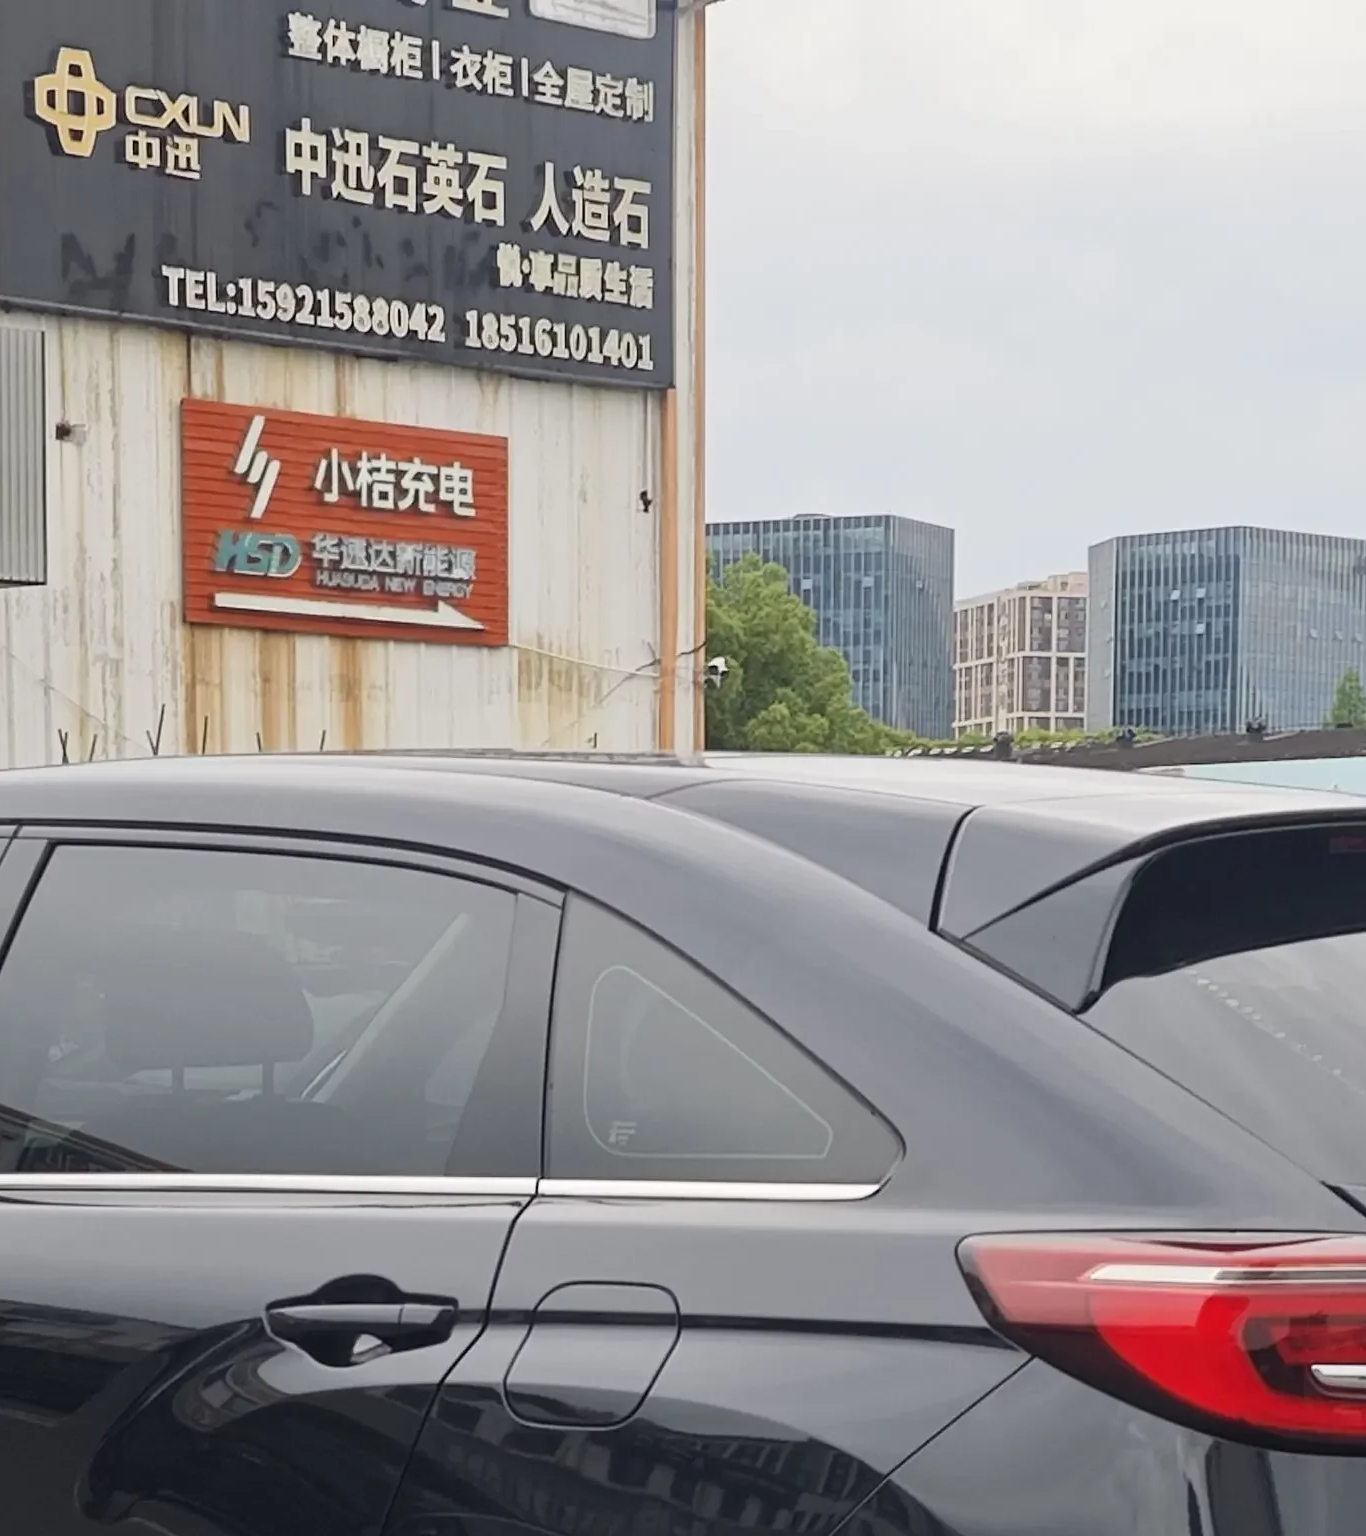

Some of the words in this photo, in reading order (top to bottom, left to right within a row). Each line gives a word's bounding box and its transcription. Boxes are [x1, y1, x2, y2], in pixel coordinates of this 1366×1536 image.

[125, 129, 201, 180] 中迅
[285, 117, 508, 227] 中迅石英石
[530, 161, 652, 249] 人造石
[464, 310, 654, 370] 18516101401
[314, 447, 476, 517] 小桔充电
